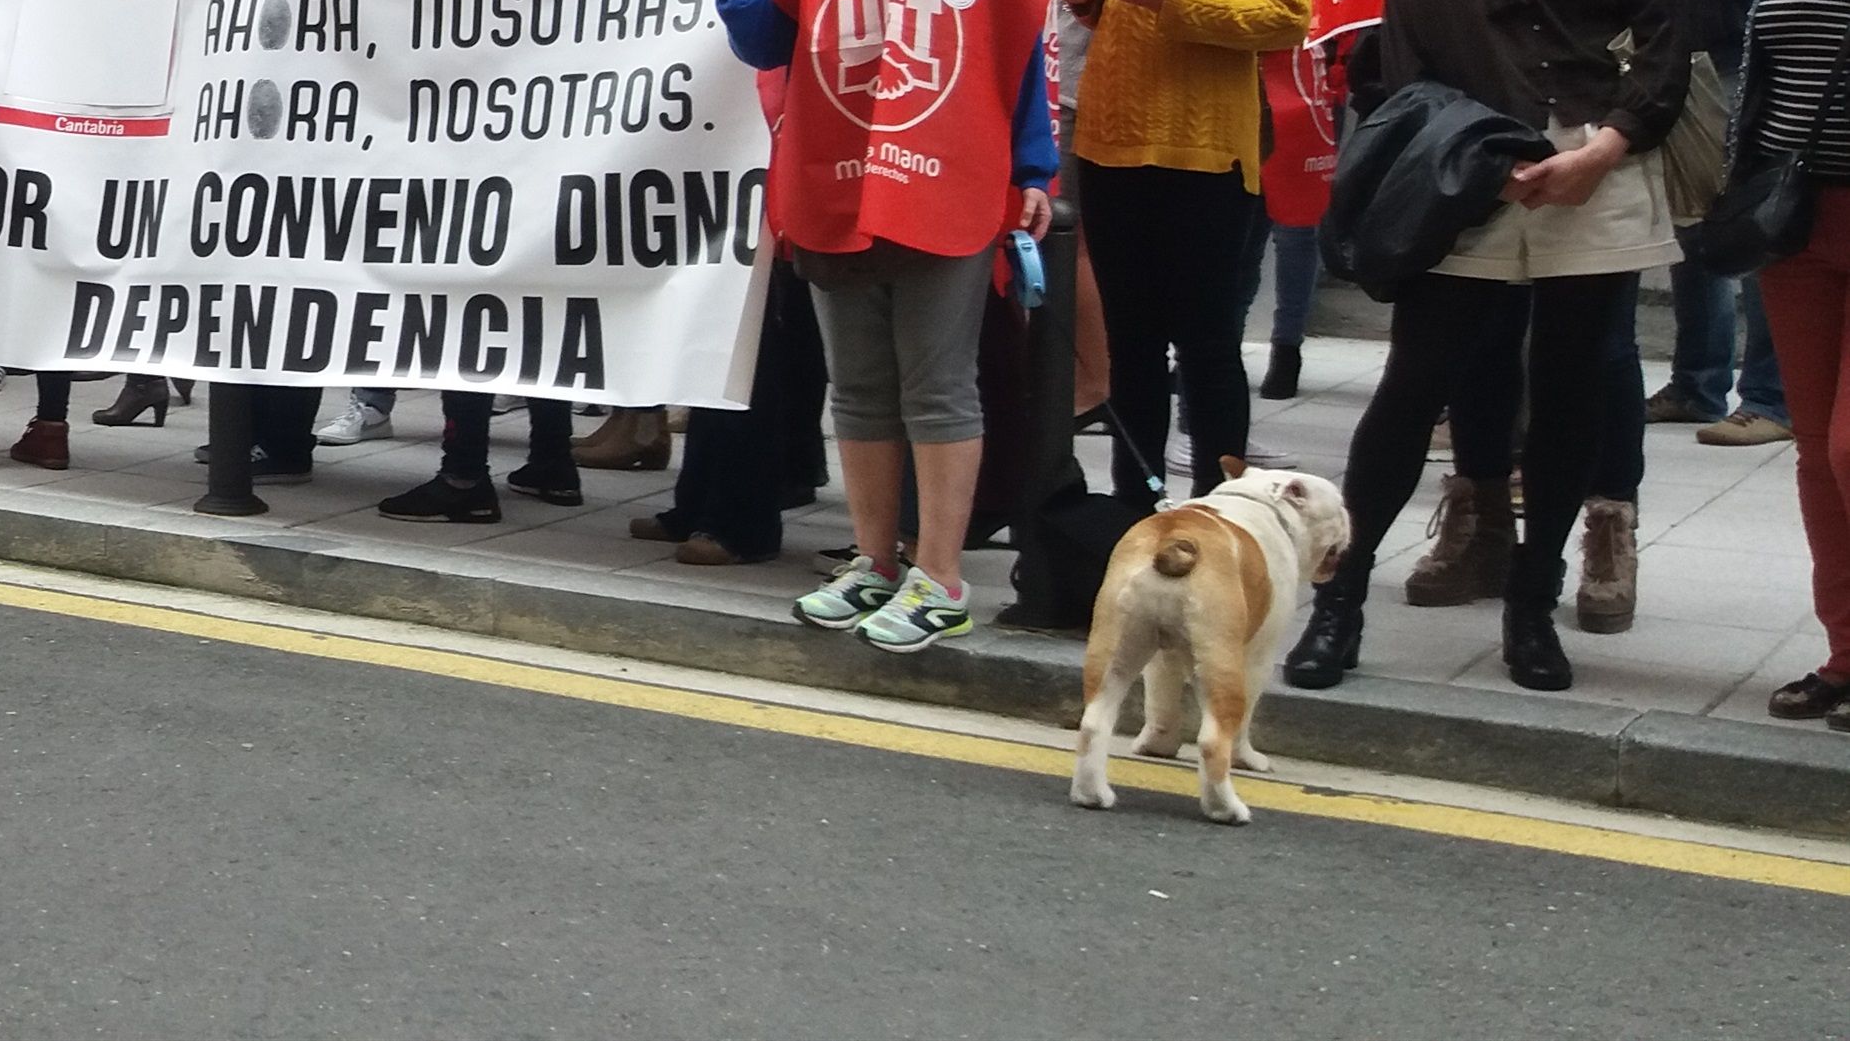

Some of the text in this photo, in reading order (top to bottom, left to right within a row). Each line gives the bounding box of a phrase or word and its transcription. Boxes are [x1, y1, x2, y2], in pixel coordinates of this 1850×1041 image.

[54, 115, 125, 136] Cantabria
[407, 62, 715, 144] NOSOTROS.
[880, 142, 940, 177] mano
[96, 178, 170, 260] UN
[190, 170, 514, 267] CONVENIO
[553, 167, 770, 269] DIGNO
[62, 279, 606, 391] DEPENDENCIA
